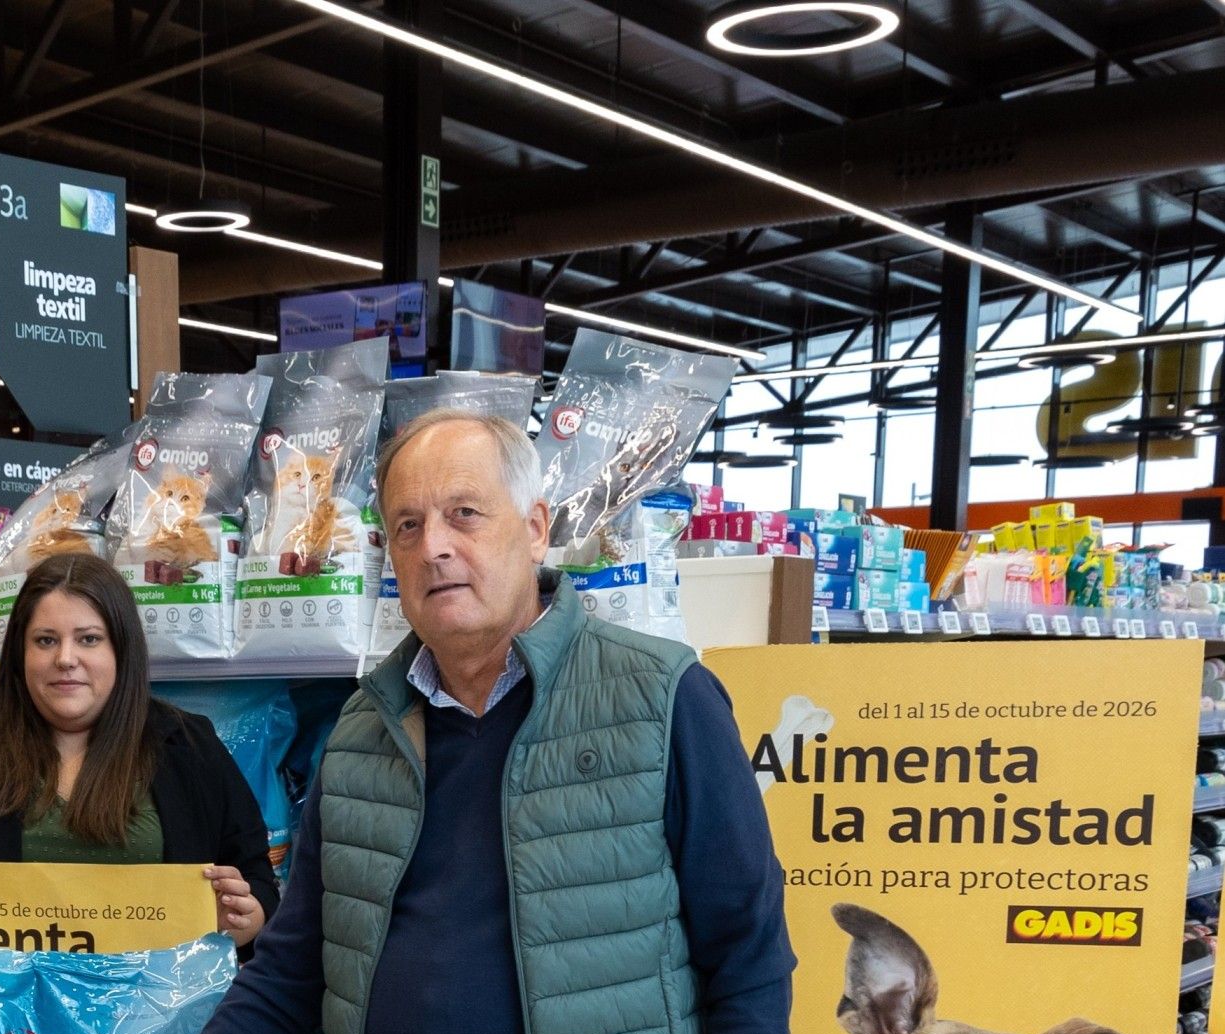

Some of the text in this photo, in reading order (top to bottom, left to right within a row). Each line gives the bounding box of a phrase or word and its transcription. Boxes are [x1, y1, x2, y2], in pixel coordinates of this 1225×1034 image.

[0, 185, 28, 219] 3a
[24, 260, 96, 295] limpeza
[37, 294, 85, 321] textil
[16, 322, 106, 349] LIMPIEZA TEXTIL
[559, 411, 574, 428] ifa
[286, 427, 340, 451] amigo
[4, 464, 22, 478] en
[26, 461, 61, 483] cáps
[140, 449, 208, 470] ifa amigo
[268, 582, 300, 592] Vegetales
[331, 577, 338, 590] 4
[340, 576, 356, 593] Kg
[858, 701, 1157, 719] del 1 al 15 de octubre de 2026
[750, 732, 1039, 784] Alimenta
[812, 793, 1155, 846] la amistad
[782, 862, 1148, 895] ación para protectoras
[12, 903, 31, 917] de
[35, 905, 98, 919] octubre
[102, 905, 121, 919] de
[126, 906, 166, 920] 2026
[1014, 909, 1139, 941] GADIS
